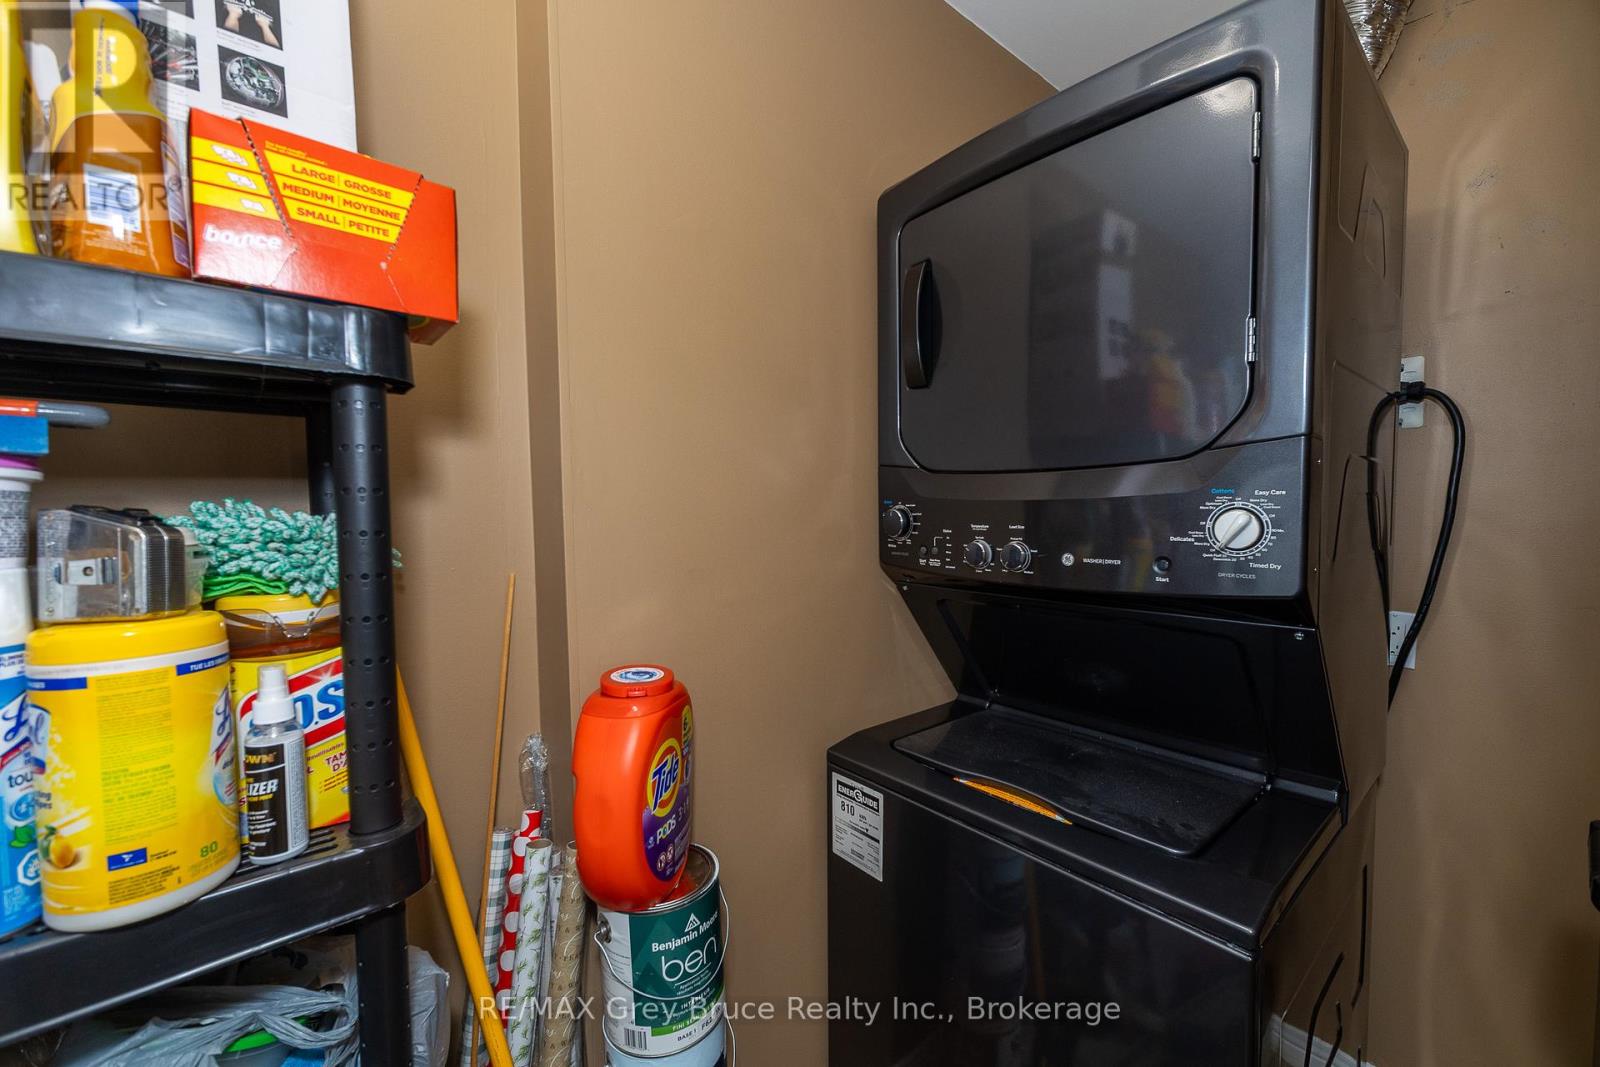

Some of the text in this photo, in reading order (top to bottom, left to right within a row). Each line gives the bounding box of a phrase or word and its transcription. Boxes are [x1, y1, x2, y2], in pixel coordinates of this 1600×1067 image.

[291, 163, 392, 200] LARGE GROSSE
[281, 181, 401, 221] MEDIUM MOYENNE
[296, 207, 391, 237] SMALL PETITE
[651, 751, 680, 815] Tide
[840, 800, 855, 816] 810
[656, 814, 677, 845] PODS
[200, 841, 218, 858] 80
[651, 910, 719, 953] Benjamin Moore
[661, 936, 718, 982] ben
